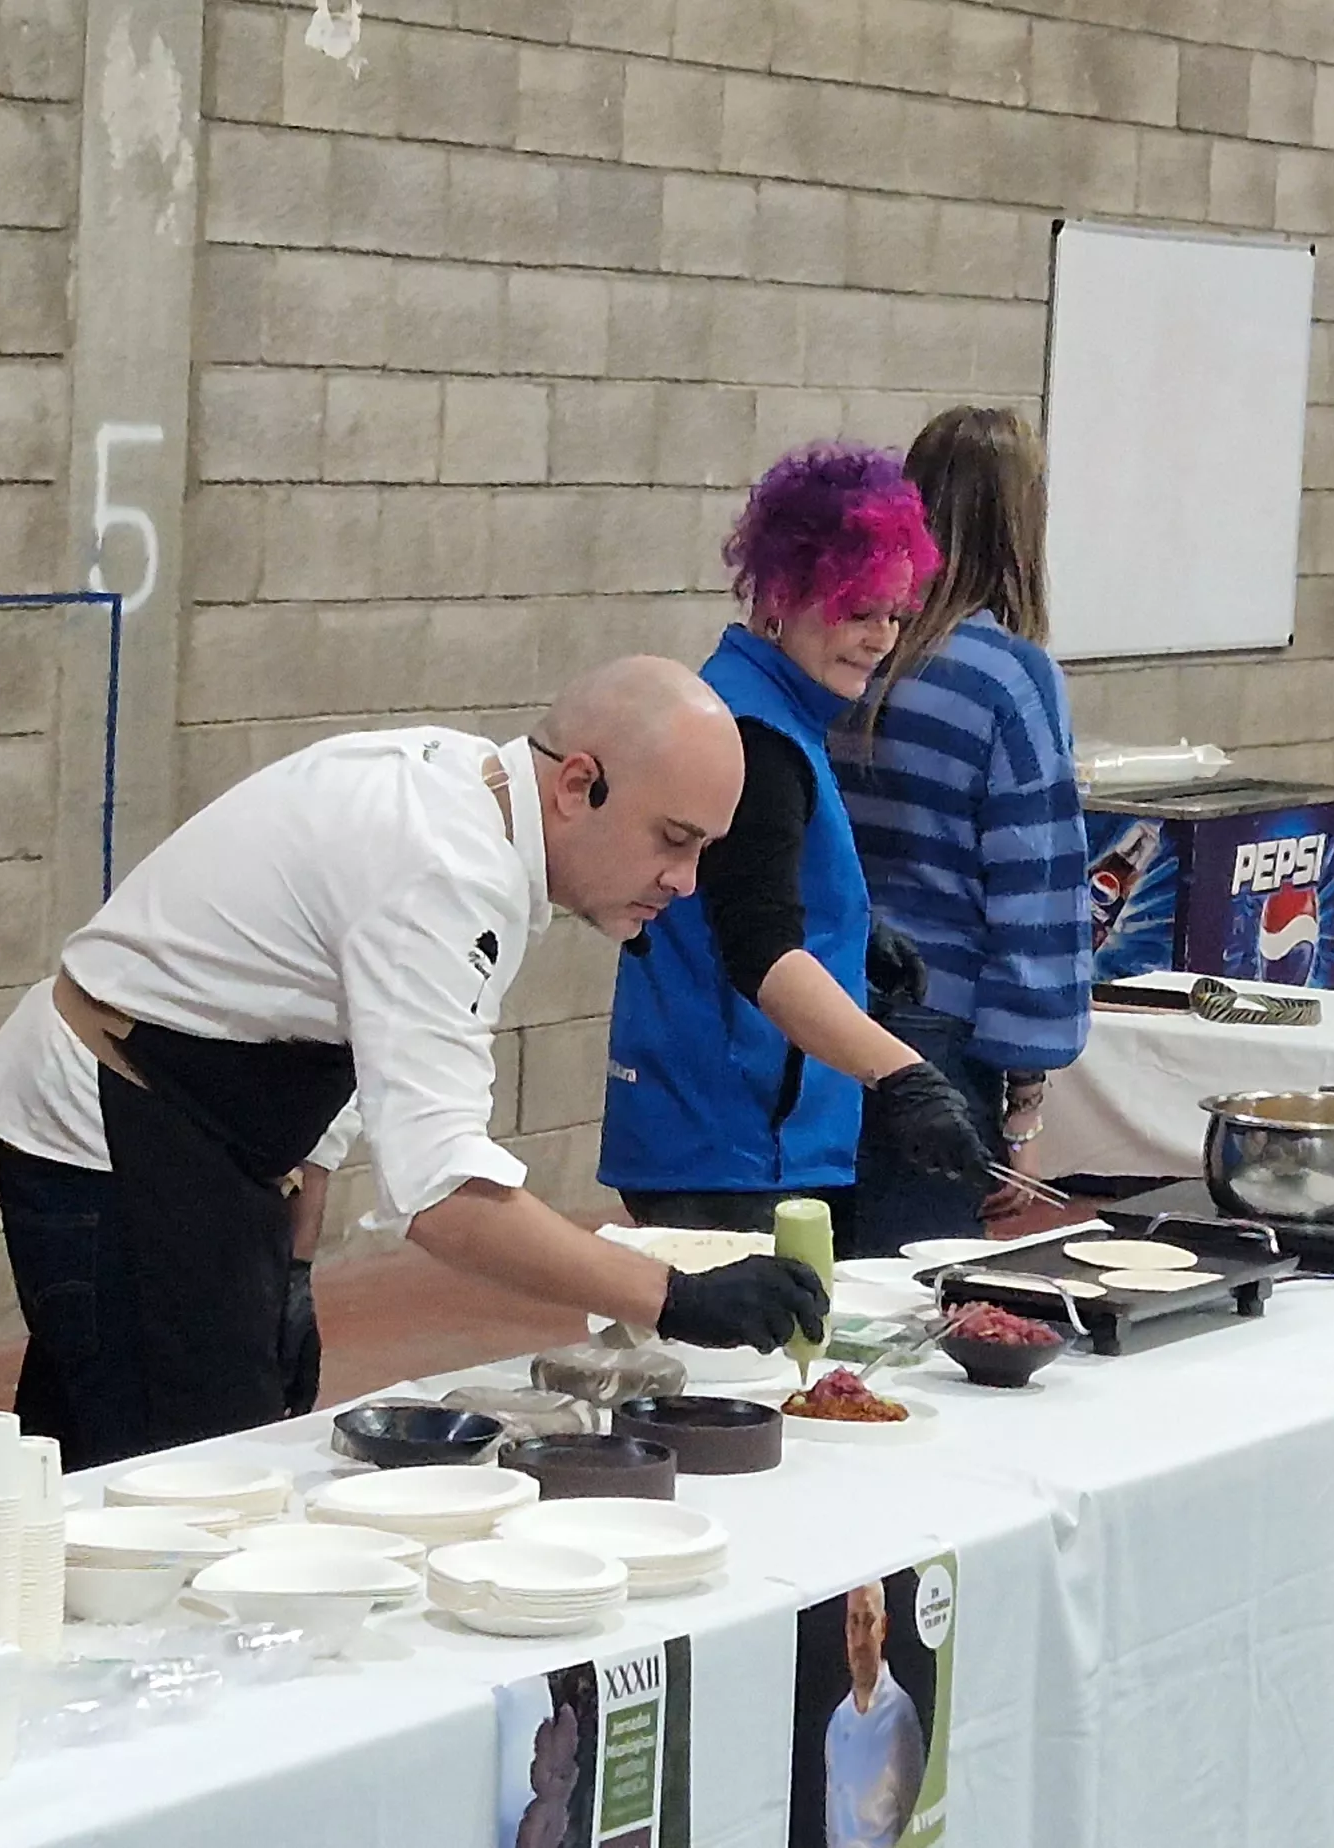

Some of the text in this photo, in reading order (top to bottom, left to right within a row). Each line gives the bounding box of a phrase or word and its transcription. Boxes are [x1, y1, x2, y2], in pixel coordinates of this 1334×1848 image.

[89, 422, 164, 616] 5
[1231, 833, 1327, 895] PEPSI
[603, 1654, 660, 1702] XXXII
